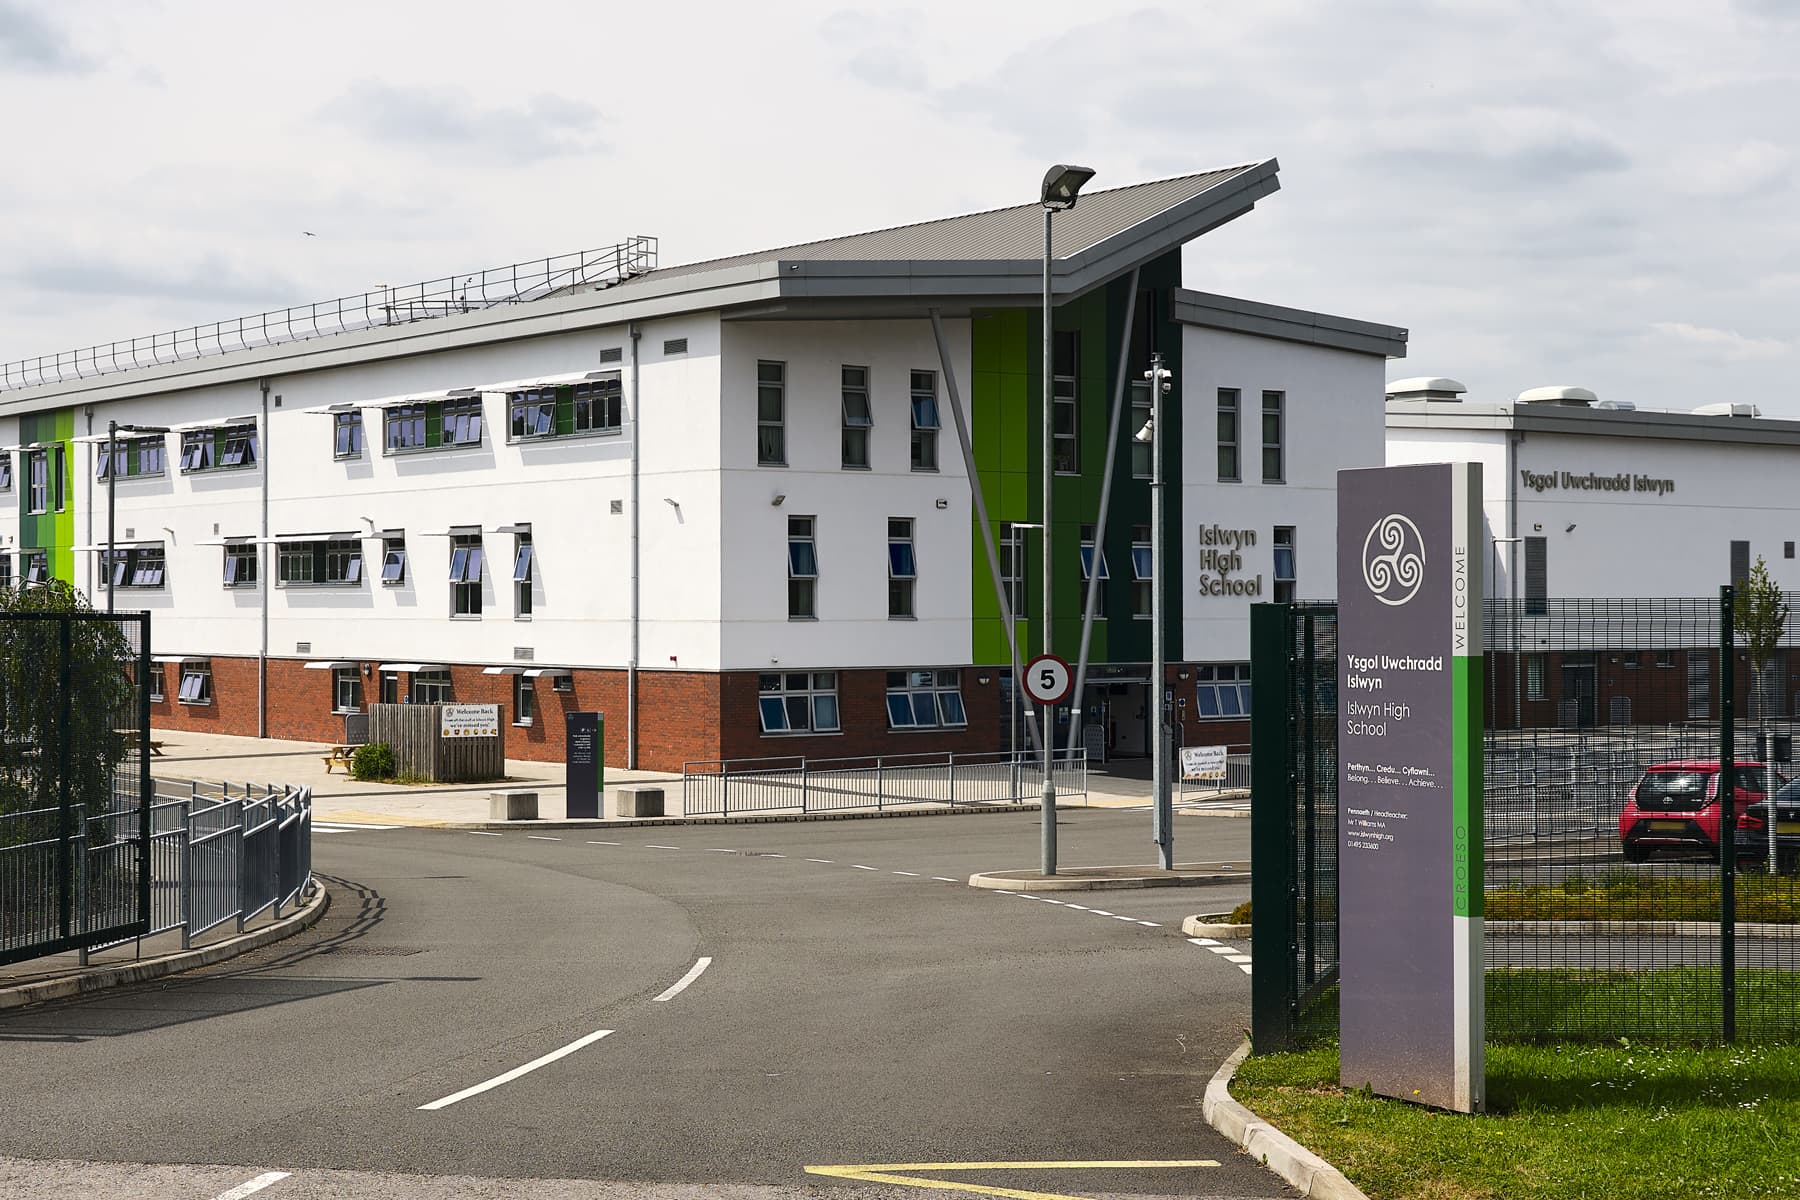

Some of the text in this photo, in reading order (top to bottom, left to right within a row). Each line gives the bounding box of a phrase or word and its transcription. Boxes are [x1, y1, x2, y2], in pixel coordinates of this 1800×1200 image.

[1520, 470, 1674, 496] Ysgol Uwchradd Islwyn
[1199, 524, 1257, 551] Islwyn
[1199, 549, 1242, 576] High
[1199, 574, 1262, 596] School
[1455, 545, 1465, 649] WELCOME
[1347, 655, 1443, 672] Ysgol Uwchradd
[1040, 669, 1056, 690] 5
[1347, 674, 1382, 692] Islwyn
[1347, 701, 1410, 720] Islwyn High
[1347, 720, 1387, 736] School
[1456, 826, 1466, 910] CROESO
